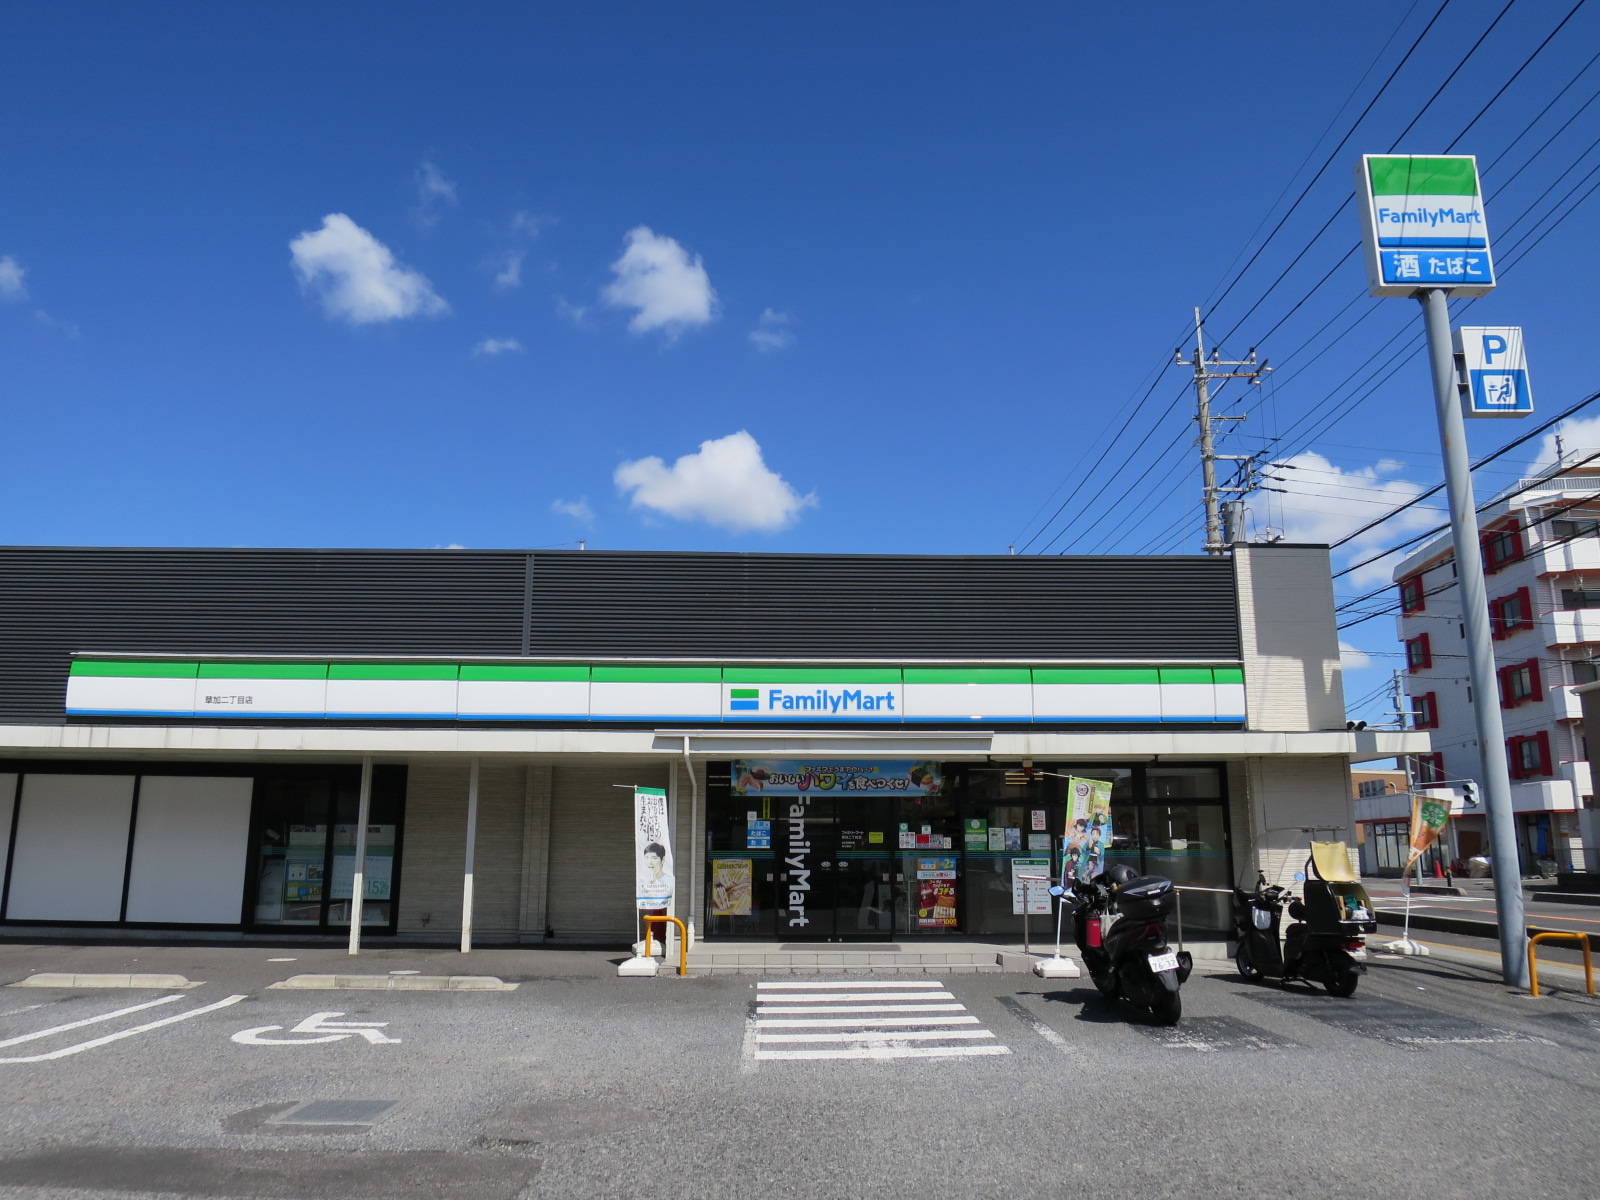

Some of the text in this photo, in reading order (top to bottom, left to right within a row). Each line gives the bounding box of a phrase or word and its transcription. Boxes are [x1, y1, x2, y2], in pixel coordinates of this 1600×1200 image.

[1379, 208, 1481, 228] FamilyMart
[1393, 254, 1483, 278] 酒 たばこ
[1482, 334, 1507, 365] P
[204, 695, 253, 704] 草加二丁目店
[769, 689, 895, 713] FamilyMart
